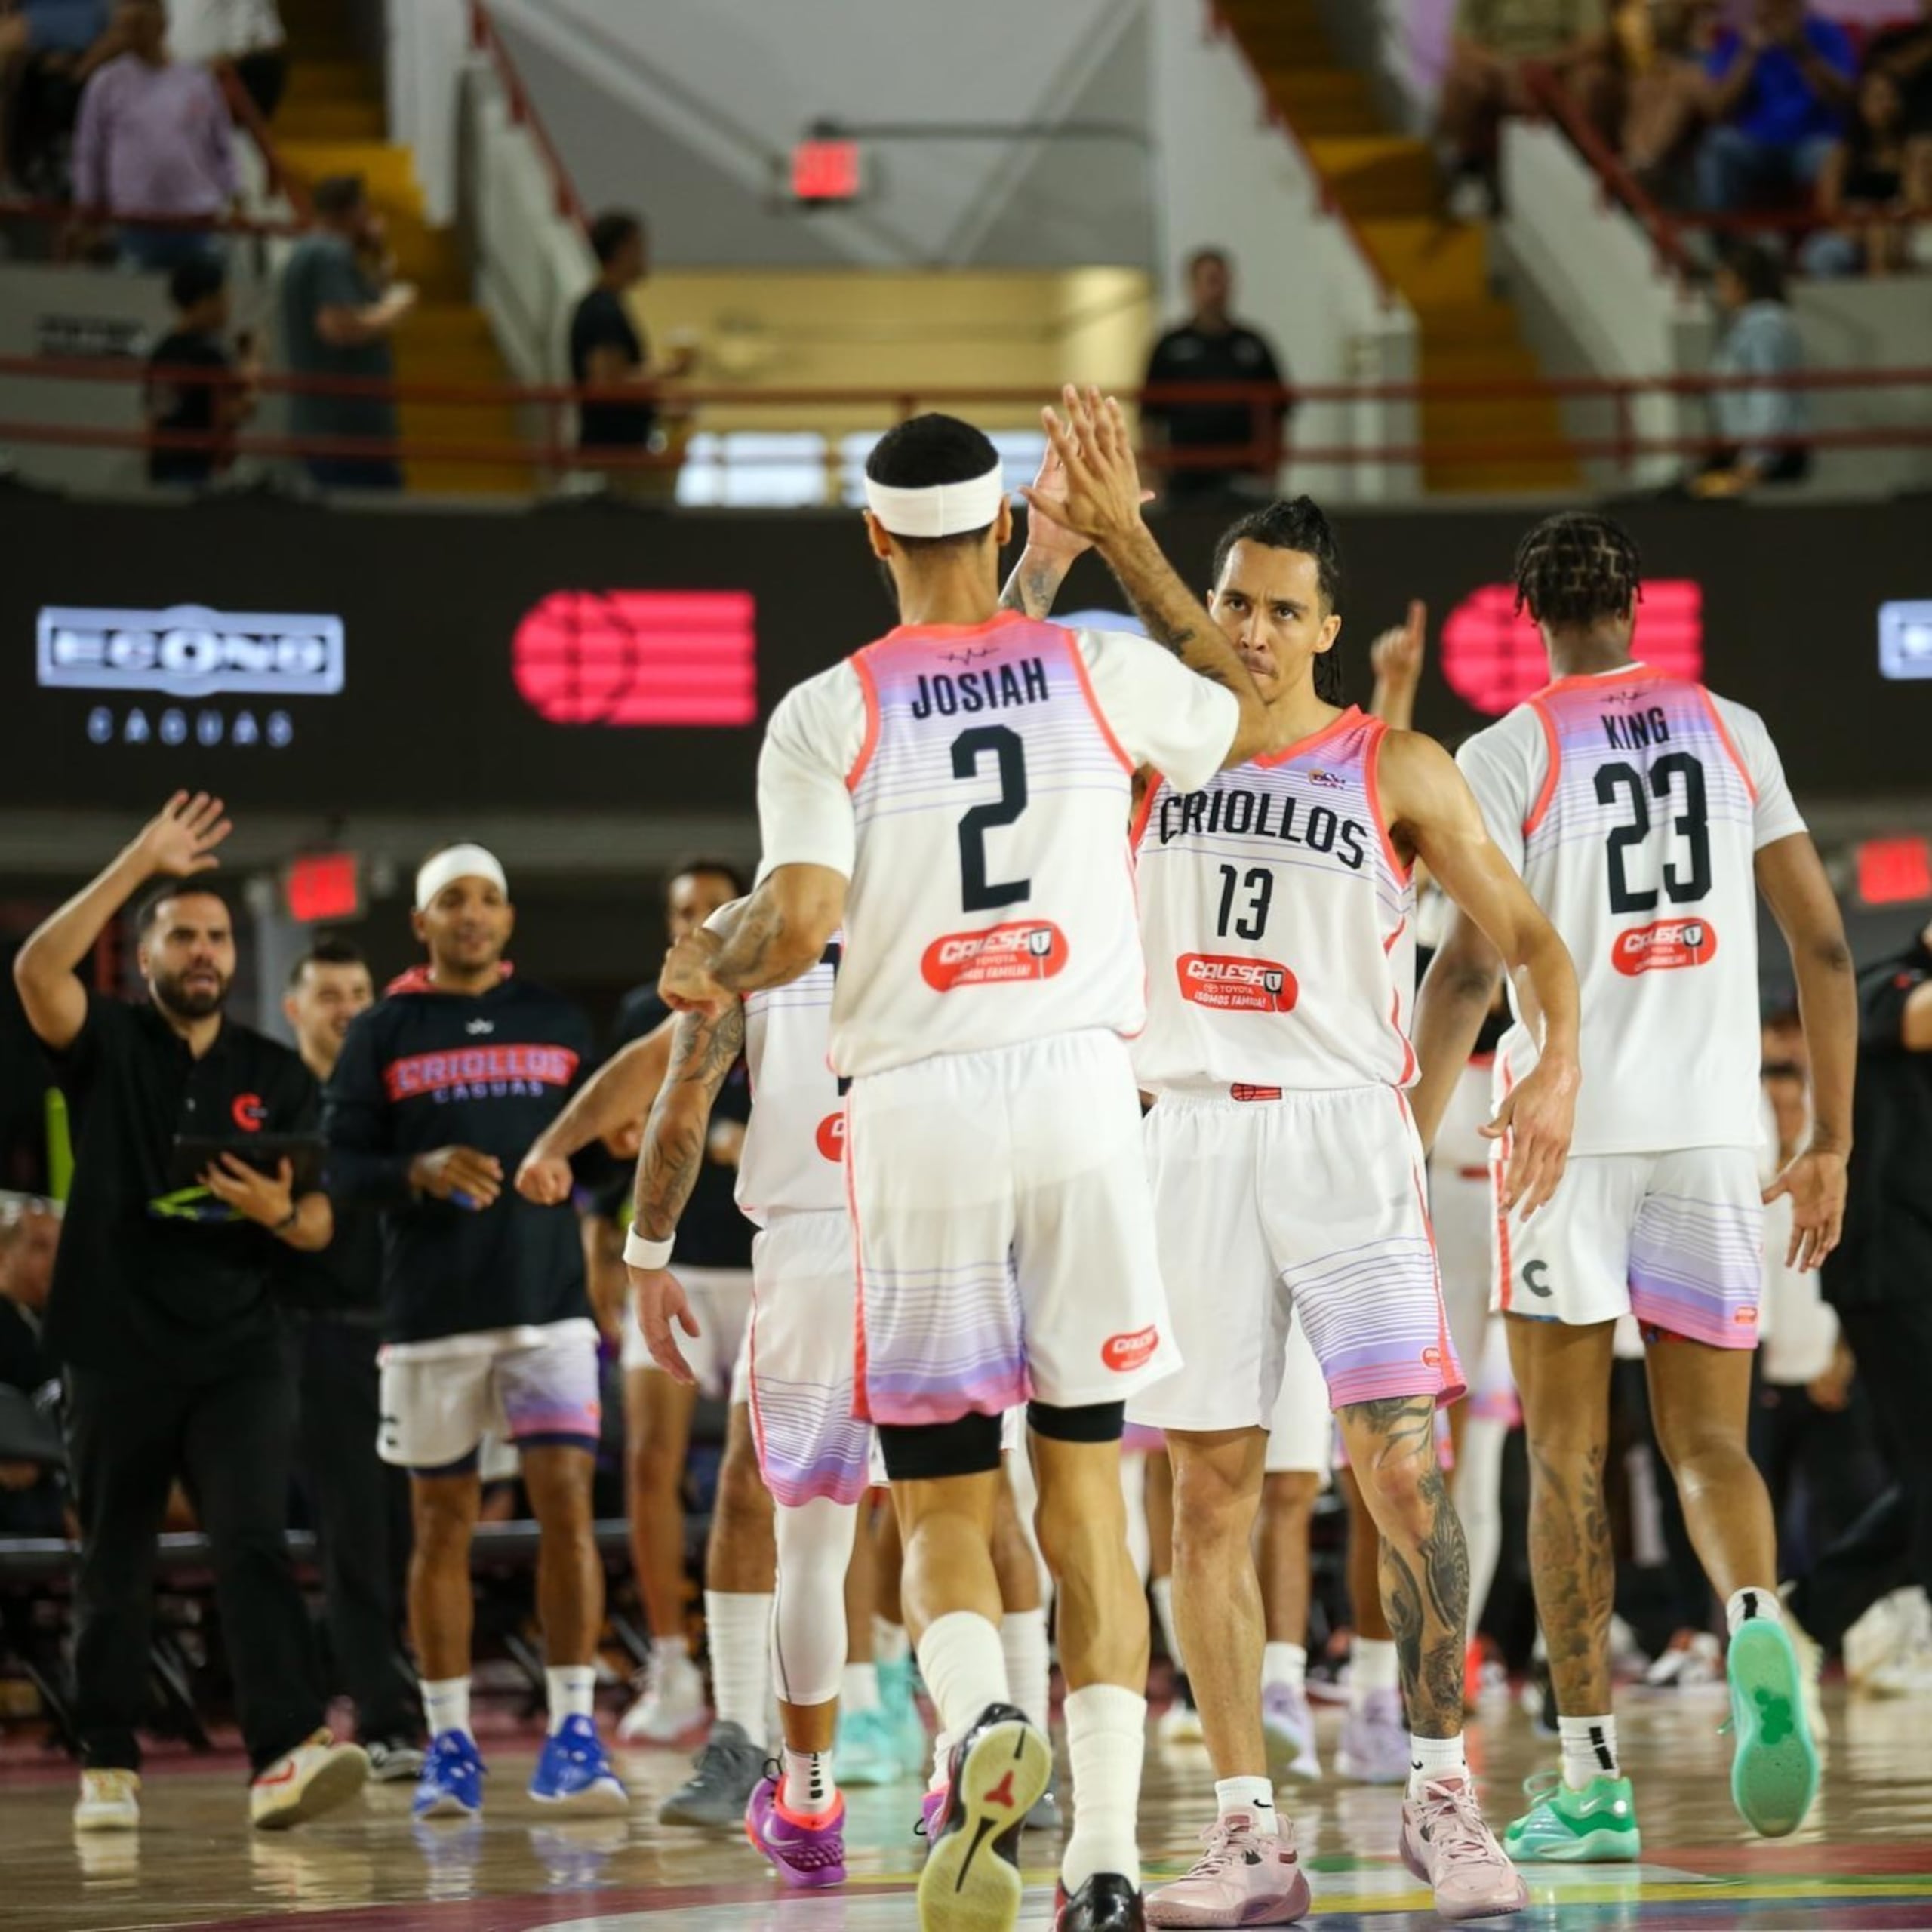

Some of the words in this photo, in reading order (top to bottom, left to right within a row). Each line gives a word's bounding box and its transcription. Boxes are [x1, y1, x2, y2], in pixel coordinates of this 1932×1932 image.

[912, 657, 1049, 720] JOSIAH
[87, 706, 294, 747] CAGUAS
[1601, 706, 1670, 749] KING
[950, 724, 1031, 913] 2
[1160, 789, 1367, 869] CRIOLLOS
[1594, 752, 1712, 915] 23
[1217, 864, 1274, 941] 13
[1220, 984, 1254, 995] TOYOTA
[398, 1048, 568, 1092] CRIOLLOS
[432, 1077, 543, 1105] CAGUAS
[1522, 1260, 1553, 1297] C
